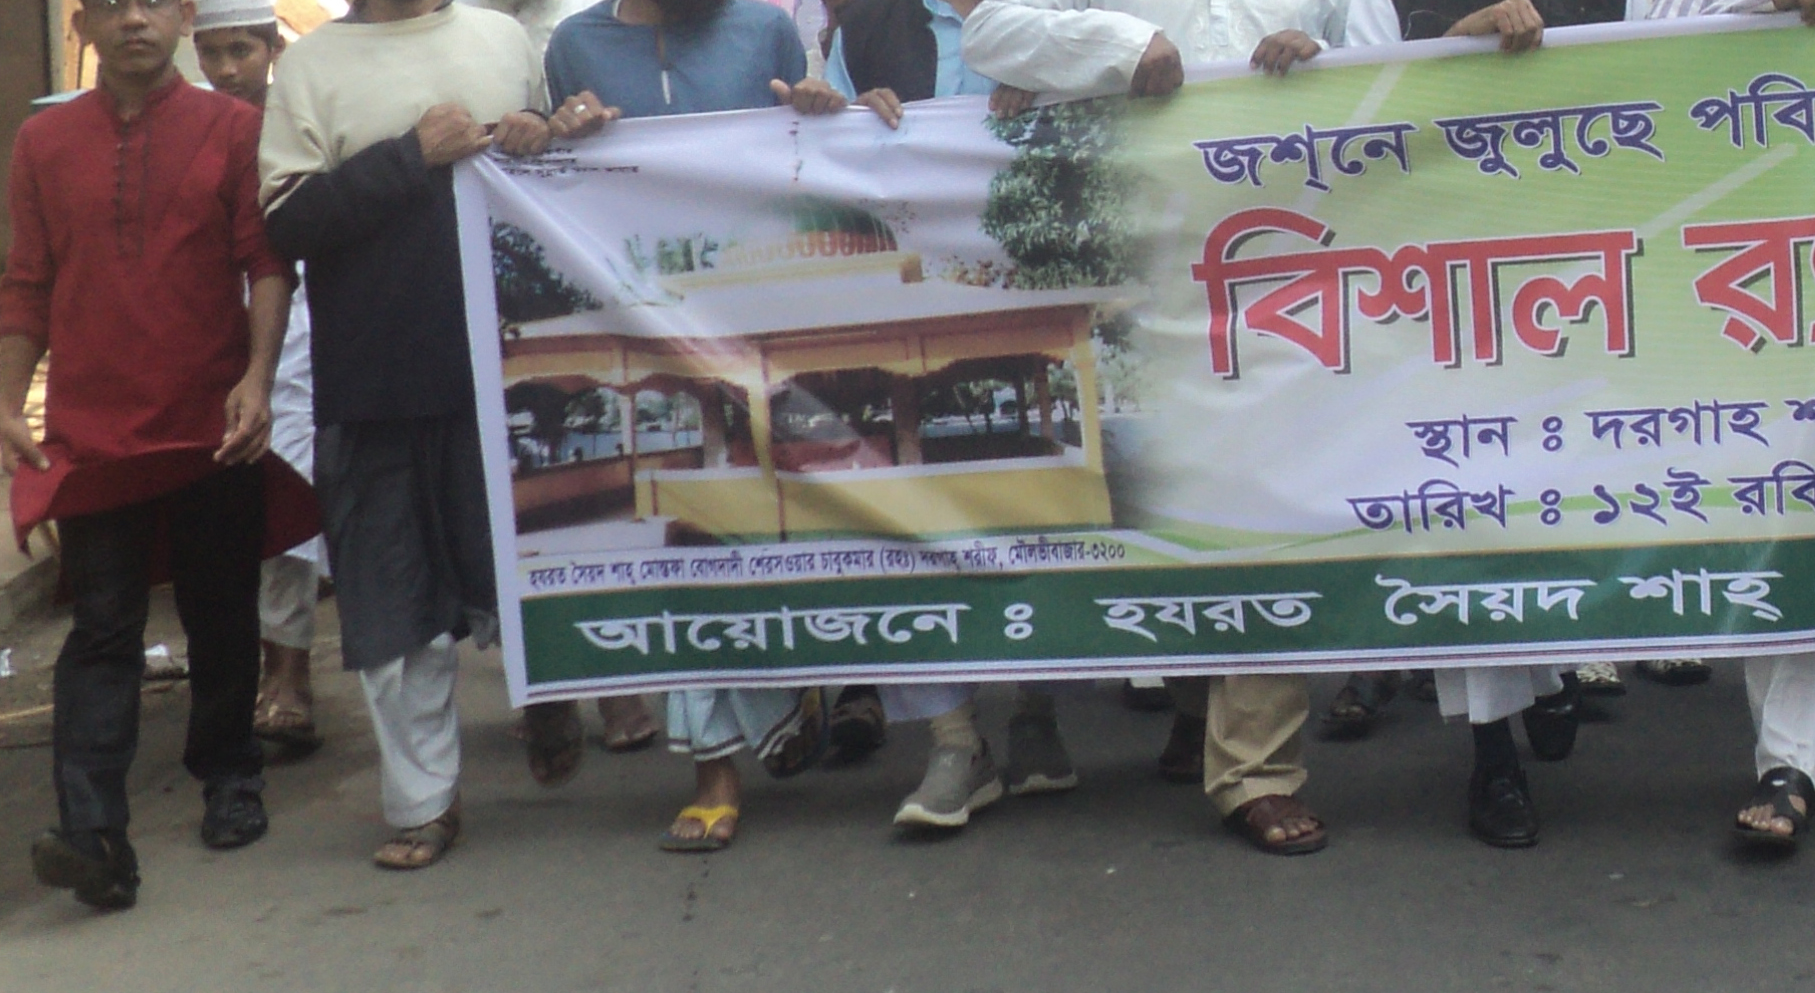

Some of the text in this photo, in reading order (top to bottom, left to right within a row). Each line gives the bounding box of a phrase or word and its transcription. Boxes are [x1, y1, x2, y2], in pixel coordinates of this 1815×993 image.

[1432, 99, 1666, 180] জুলুছে
[1191, 206, 1645, 381] বিশাল
[1405, 411, 1517, 468] স্থান
[1584, 399, 1770, 450] দরগাহ
[1346, 478, 1516, 534] তারিখ
[1592, 467, 1712, 526] ১২ই
[573, 603, 971, 655] আয়োজনে
[1093, 590, 1323, 644] হযরত
[1374, 572, 1598, 626] সৈয়দ
